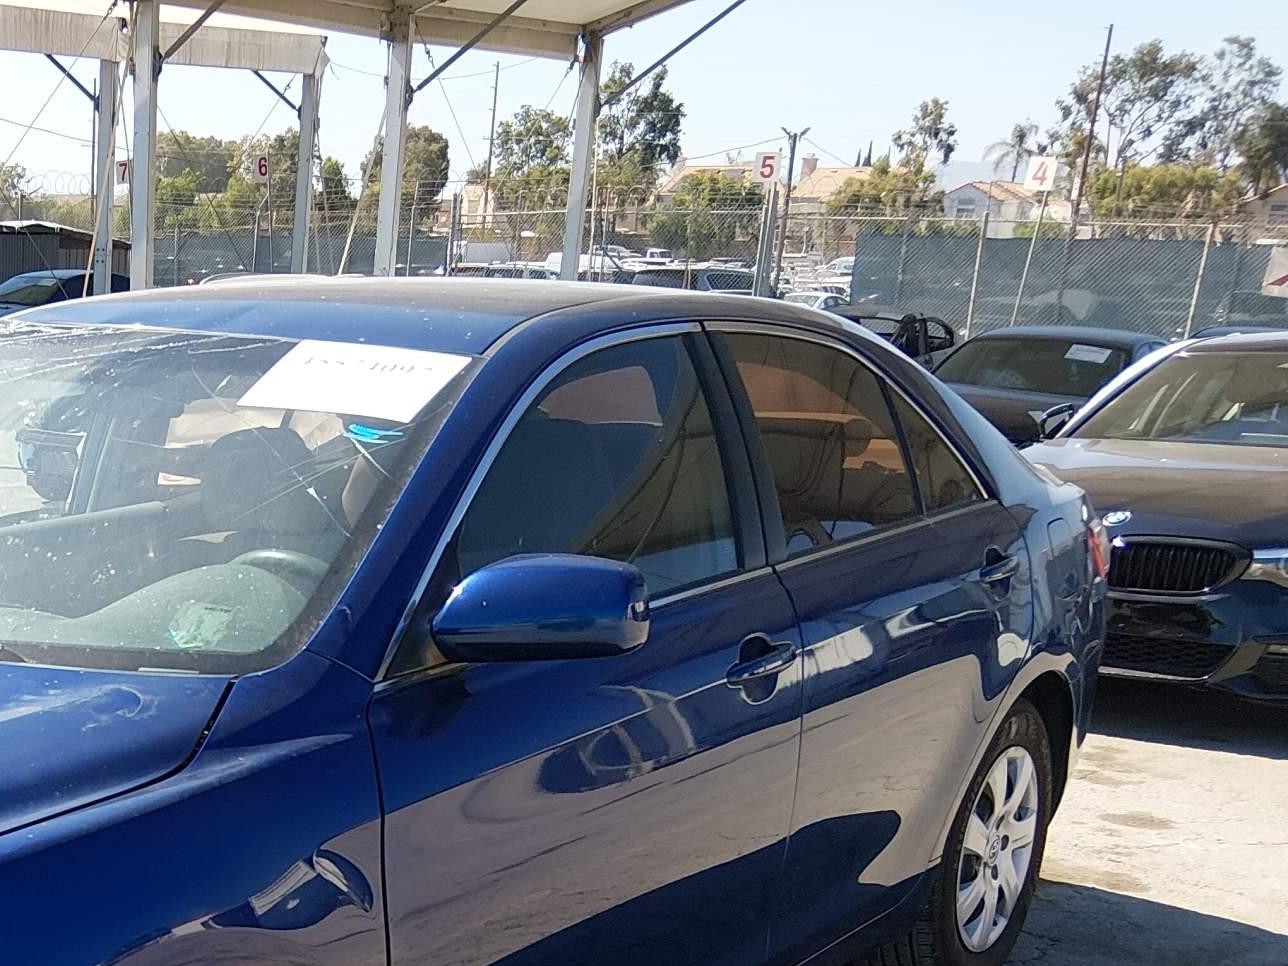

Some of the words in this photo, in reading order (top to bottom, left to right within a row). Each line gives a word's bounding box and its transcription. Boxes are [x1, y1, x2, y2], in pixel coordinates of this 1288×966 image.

[118, 163, 128, 181] 7
[258, 156, 268, 177] 6
[759, 155, 775, 178] 5
[1031, 160, 1048, 186] 4
